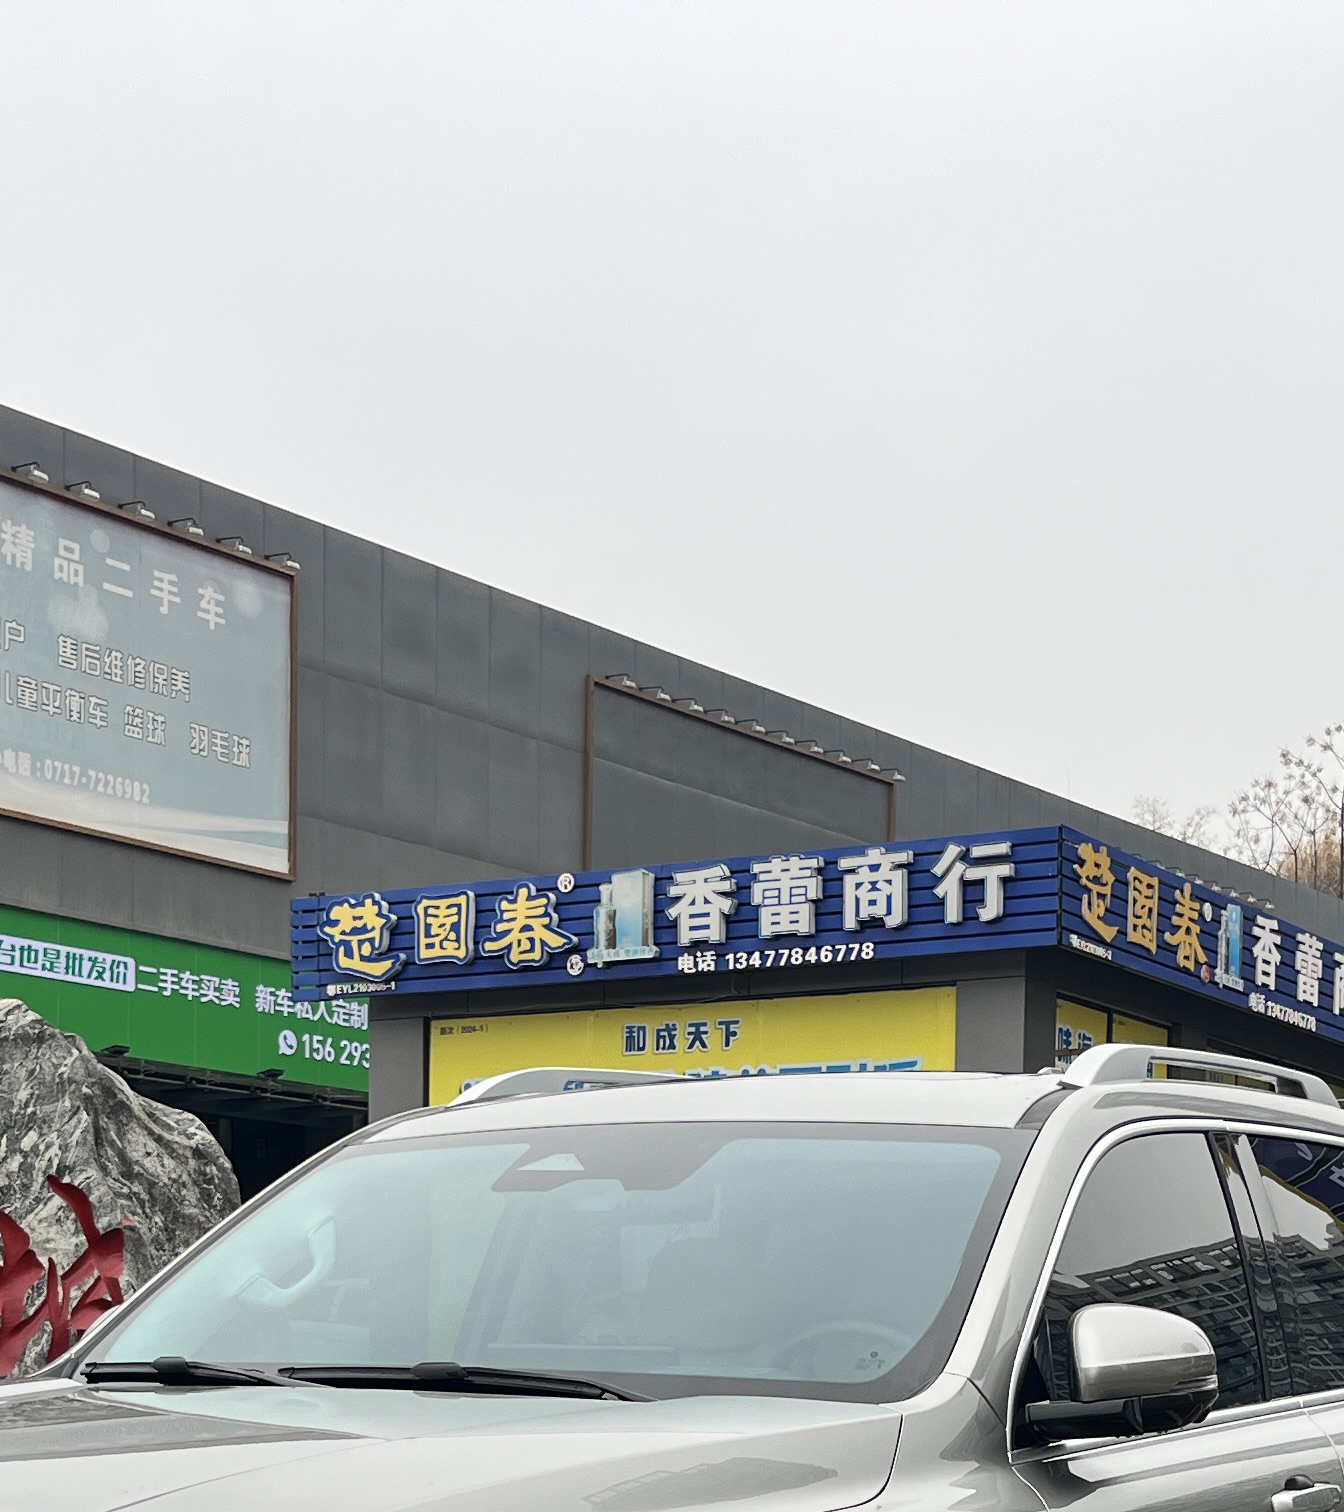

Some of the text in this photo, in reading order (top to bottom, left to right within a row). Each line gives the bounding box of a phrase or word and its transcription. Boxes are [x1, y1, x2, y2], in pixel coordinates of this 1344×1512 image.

[56, 633, 191, 703] 售后维修保养
[123, 703, 167, 747] 篮球
[189, 721, 252, 769] 羽毛球
[664, 840, 1016, 947] 香蕾商行
[676, 949, 717, 974] 电话
[724, 942, 876, 972] 13477846778
[136, 965, 241, 1008] 二手车买卖
[254, 984, 369, 1031] 新车私人定制
[302, 1033, 336, 1062] 156
[623, 1018, 742, 1056] 和成天下
